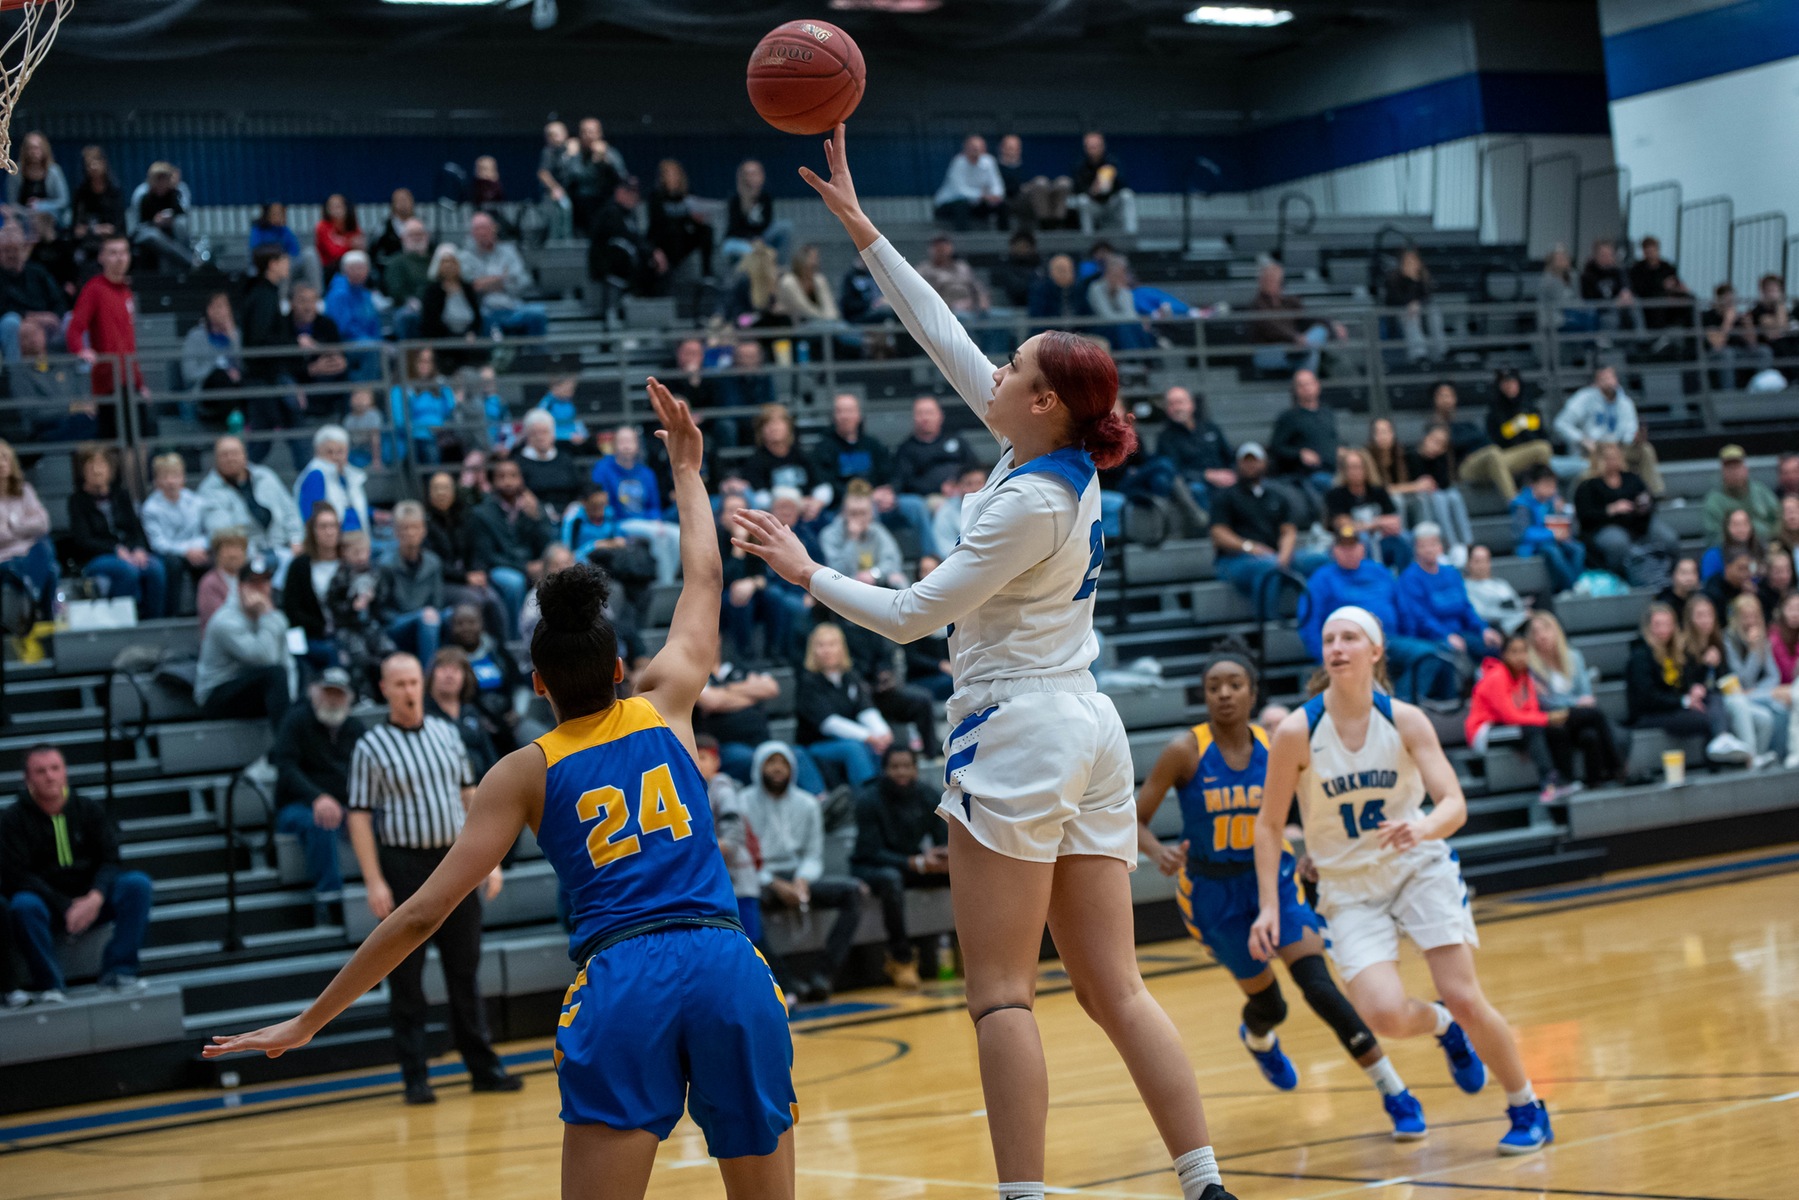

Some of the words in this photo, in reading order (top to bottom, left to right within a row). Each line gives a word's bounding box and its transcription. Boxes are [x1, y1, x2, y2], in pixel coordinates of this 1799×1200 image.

[1321, 769, 1398, 798] KIRKWOOD
[575, 762, 693, 870] 24
[1213, 814, 1256, 852] 10
[1338, 798, 1387, 839] 14
